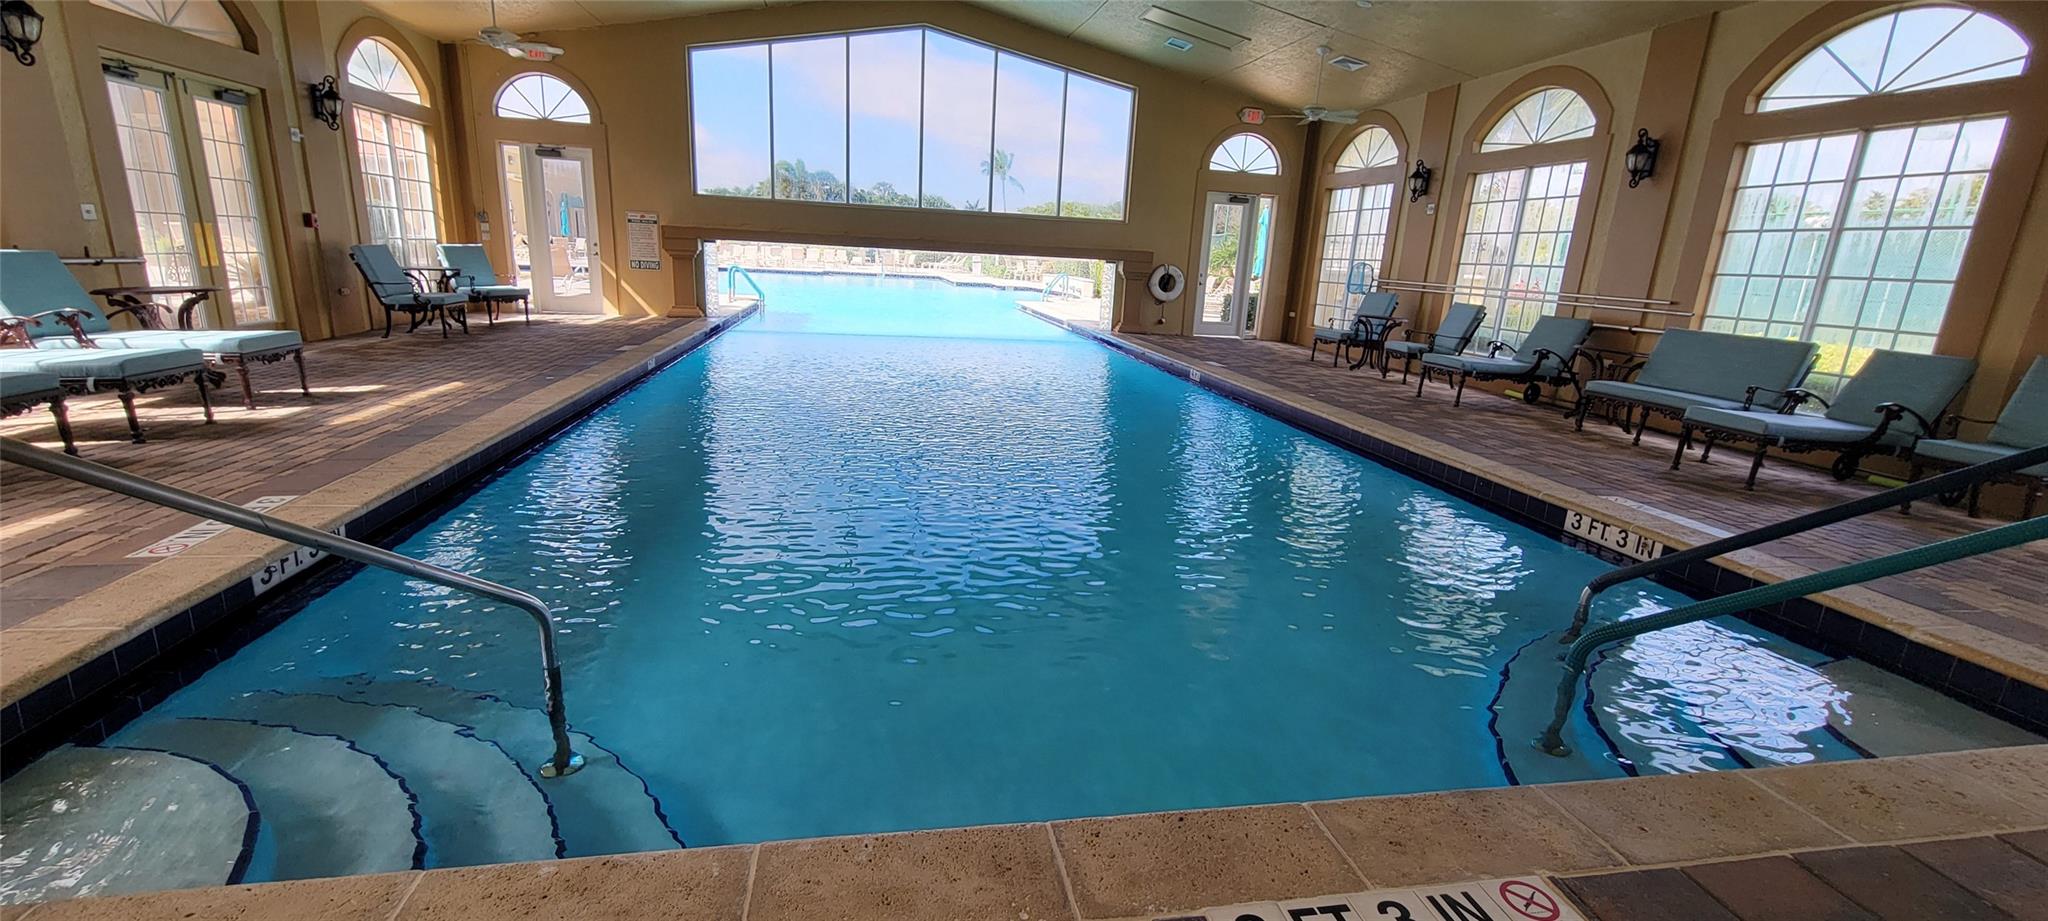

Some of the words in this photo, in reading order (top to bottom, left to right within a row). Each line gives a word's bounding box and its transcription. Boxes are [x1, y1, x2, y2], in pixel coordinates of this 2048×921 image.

[631, 260, 640, 269] NO
[640, 261, 659, 269] DIVING
[1571, 512, 1583, 530] 3
[1587, 518, 1610, 541] FT.
[1616, 529, 1629, 548] 3
[1425, 891, 1494, 921] IN
